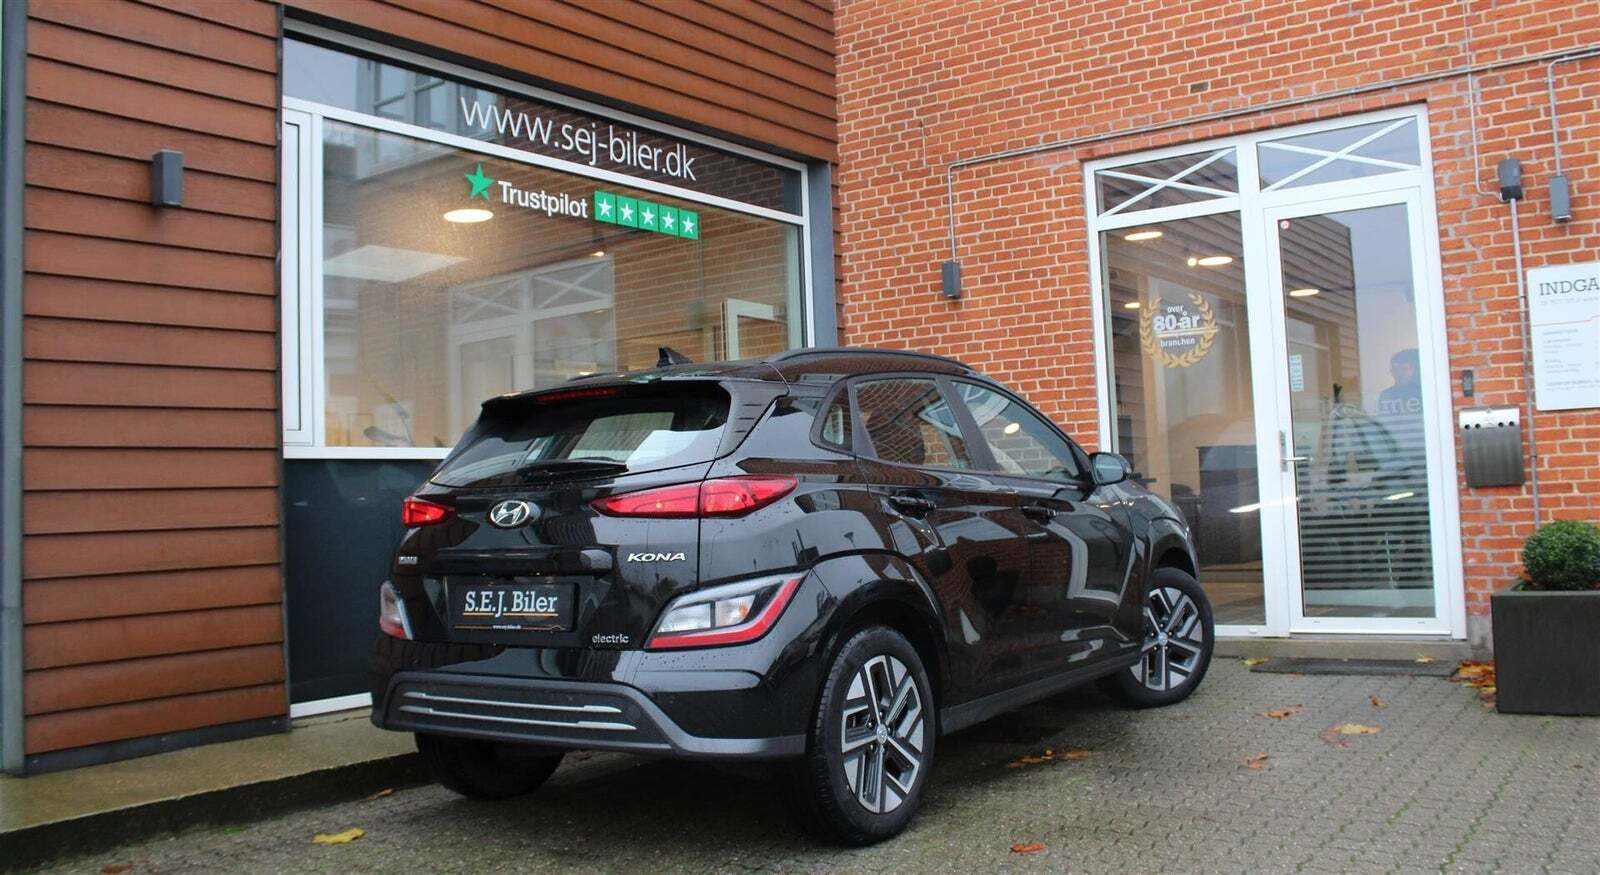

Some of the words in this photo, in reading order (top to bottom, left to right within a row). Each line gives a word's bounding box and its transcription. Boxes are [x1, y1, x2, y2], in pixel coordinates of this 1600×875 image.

[460, 97, 696, 181] www.sej-biler.dk
[498, 180, 588, 219] Trustpilot
[1167, 304, 1184, 313] over
[1160, 337, 1195, 348] branchen
[627, 552, 686, 562] KONA
[464, 590, 507, 618] S.E.J.
[511, 590, 558, 612] Biler
[591, 633, 629, 644] electric
